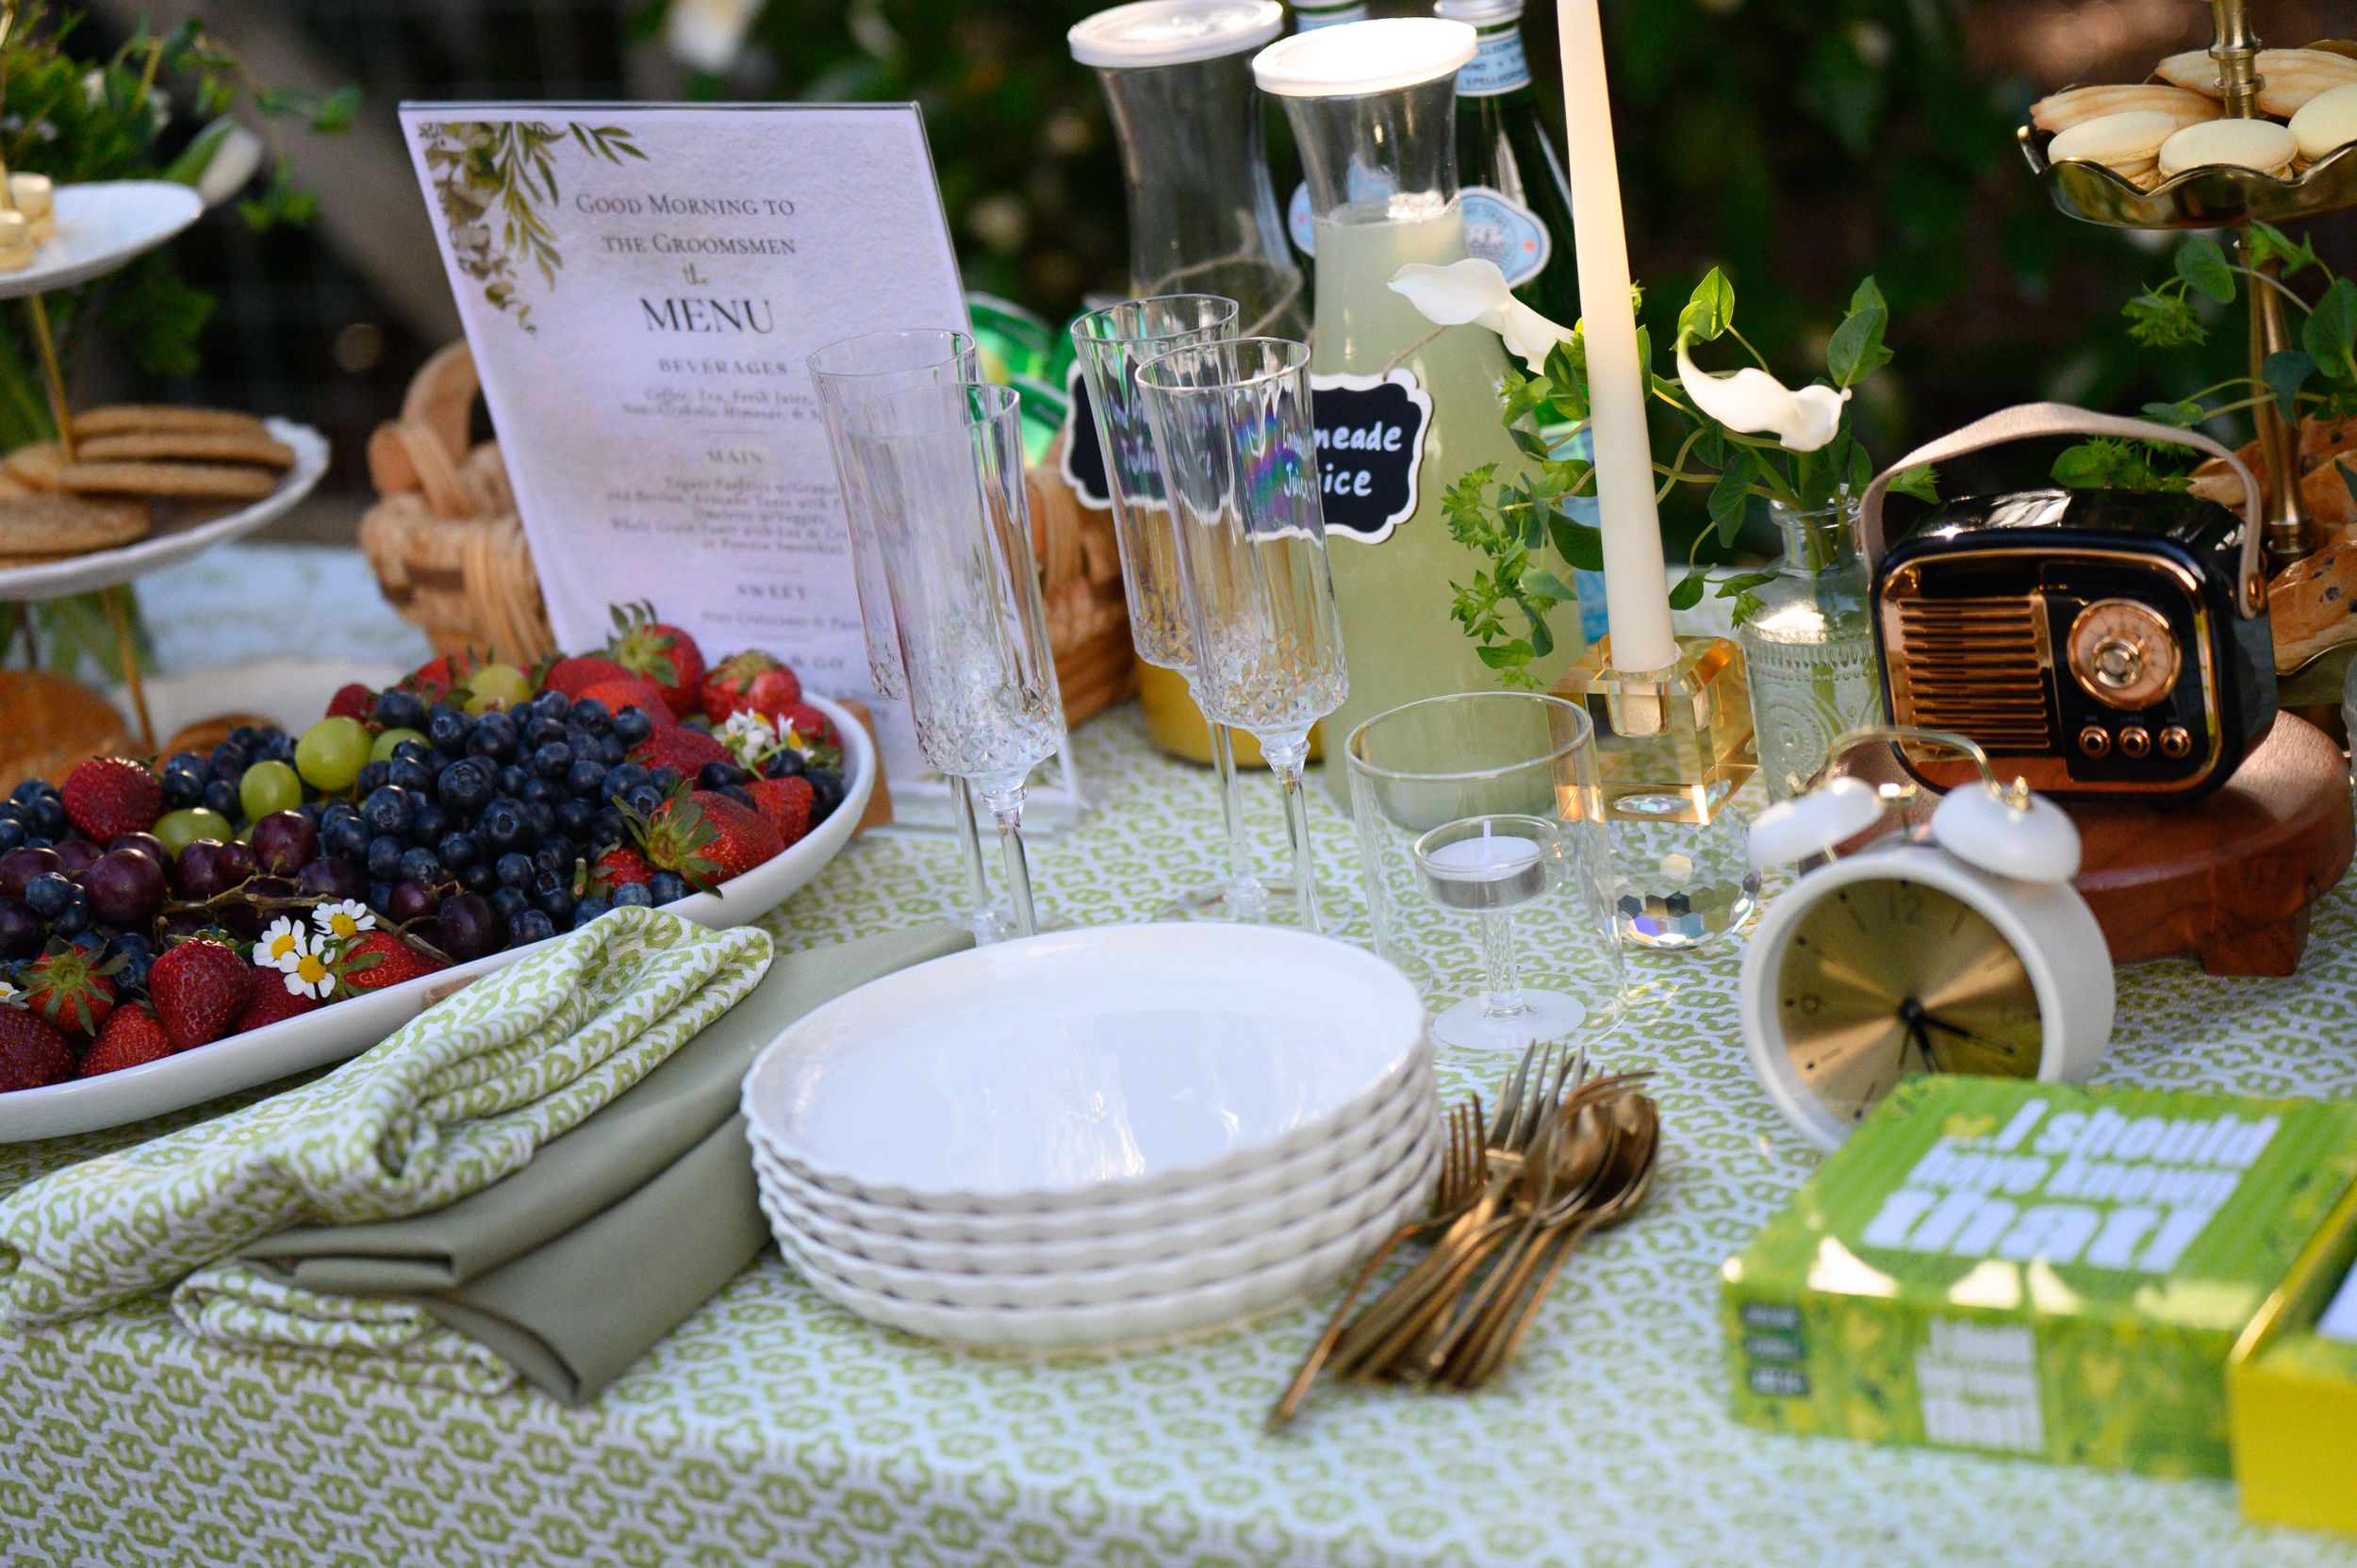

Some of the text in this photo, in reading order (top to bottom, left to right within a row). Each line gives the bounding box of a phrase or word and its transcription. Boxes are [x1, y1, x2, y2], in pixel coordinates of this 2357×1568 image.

[652, 233, 796, 255] GROOMSMEN
[639, 298, 774, 334] MENU
[659, 358, 788, 375] BEVERAGES
[707, 449, 764, 465] MAIN
[2033, 1106, 2282, 1168] should
[2044, 1153, 2241, 1207] known
